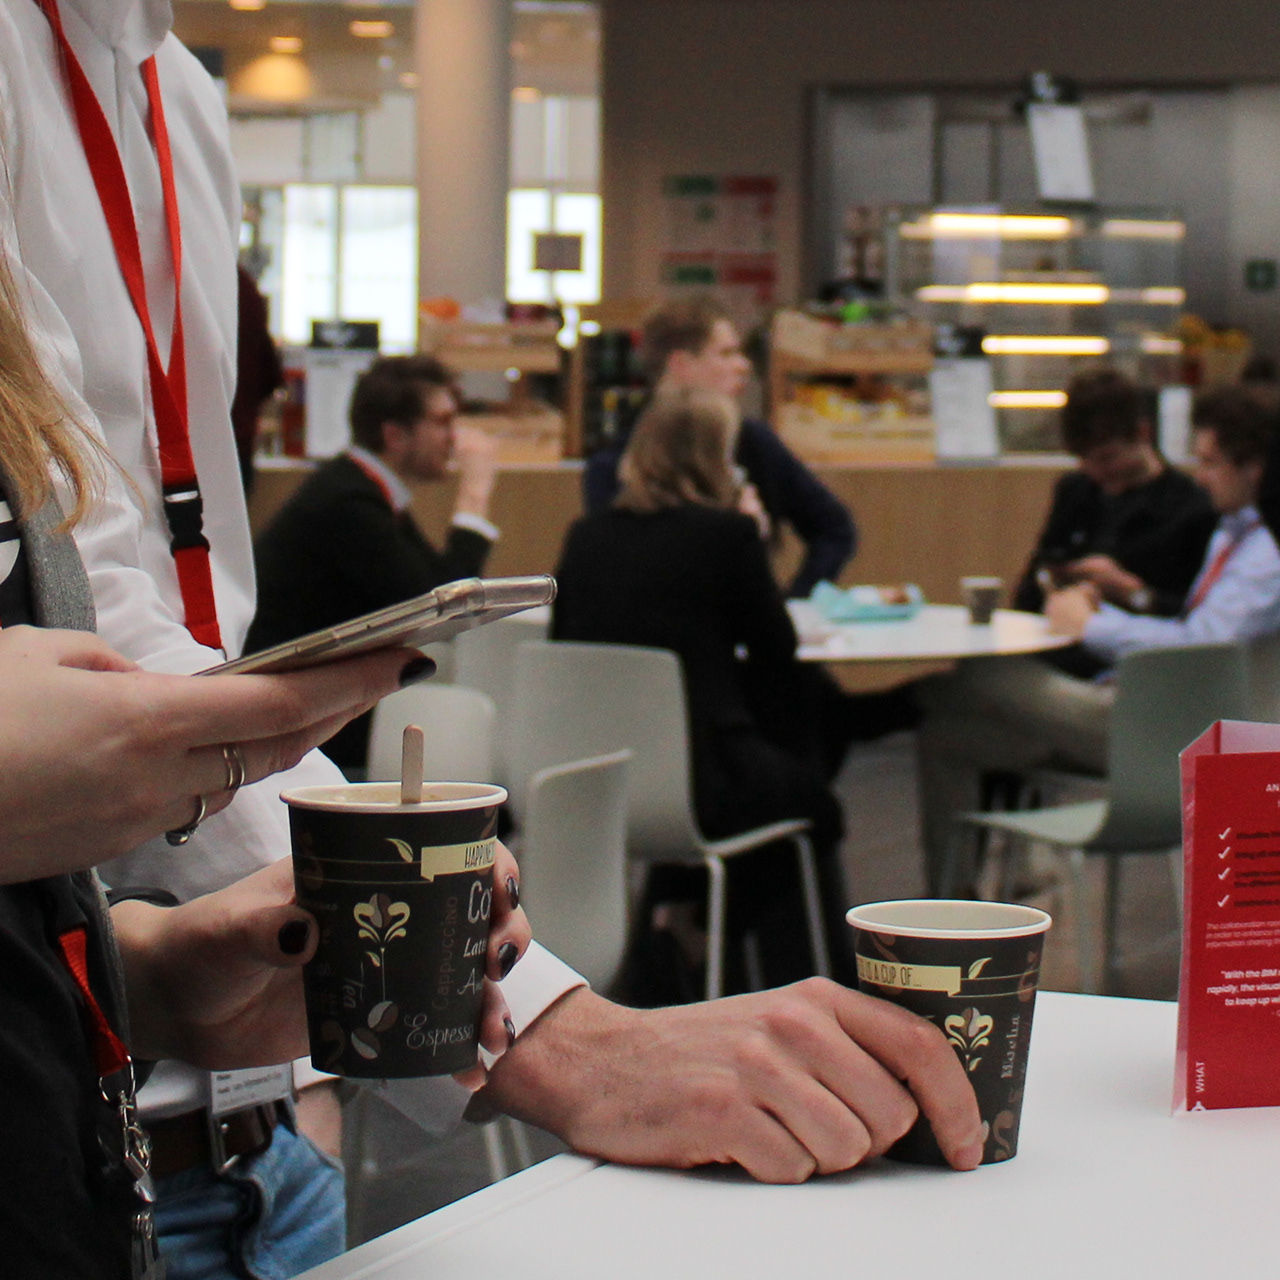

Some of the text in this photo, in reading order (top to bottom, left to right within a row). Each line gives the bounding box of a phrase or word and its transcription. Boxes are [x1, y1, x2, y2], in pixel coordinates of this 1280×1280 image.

[1265, 783, 1280, 792] AN
[467, 880, 493, 924] Co
[432, 896, 458, 1010] Cappuccino
[881, 964, 896, 985] CUP
[1246, 970, 1260, 978] the
[1240, 984, 1255, 992] the
[1225, 998, 1234, 1006] to
[1235, 996, 1257, 1007] keep
[1258, 996, 1270, 1006] up
[404, 1014, 474, 1056] Espresso
[1196, 1061, 1205, 1093] WHAT
